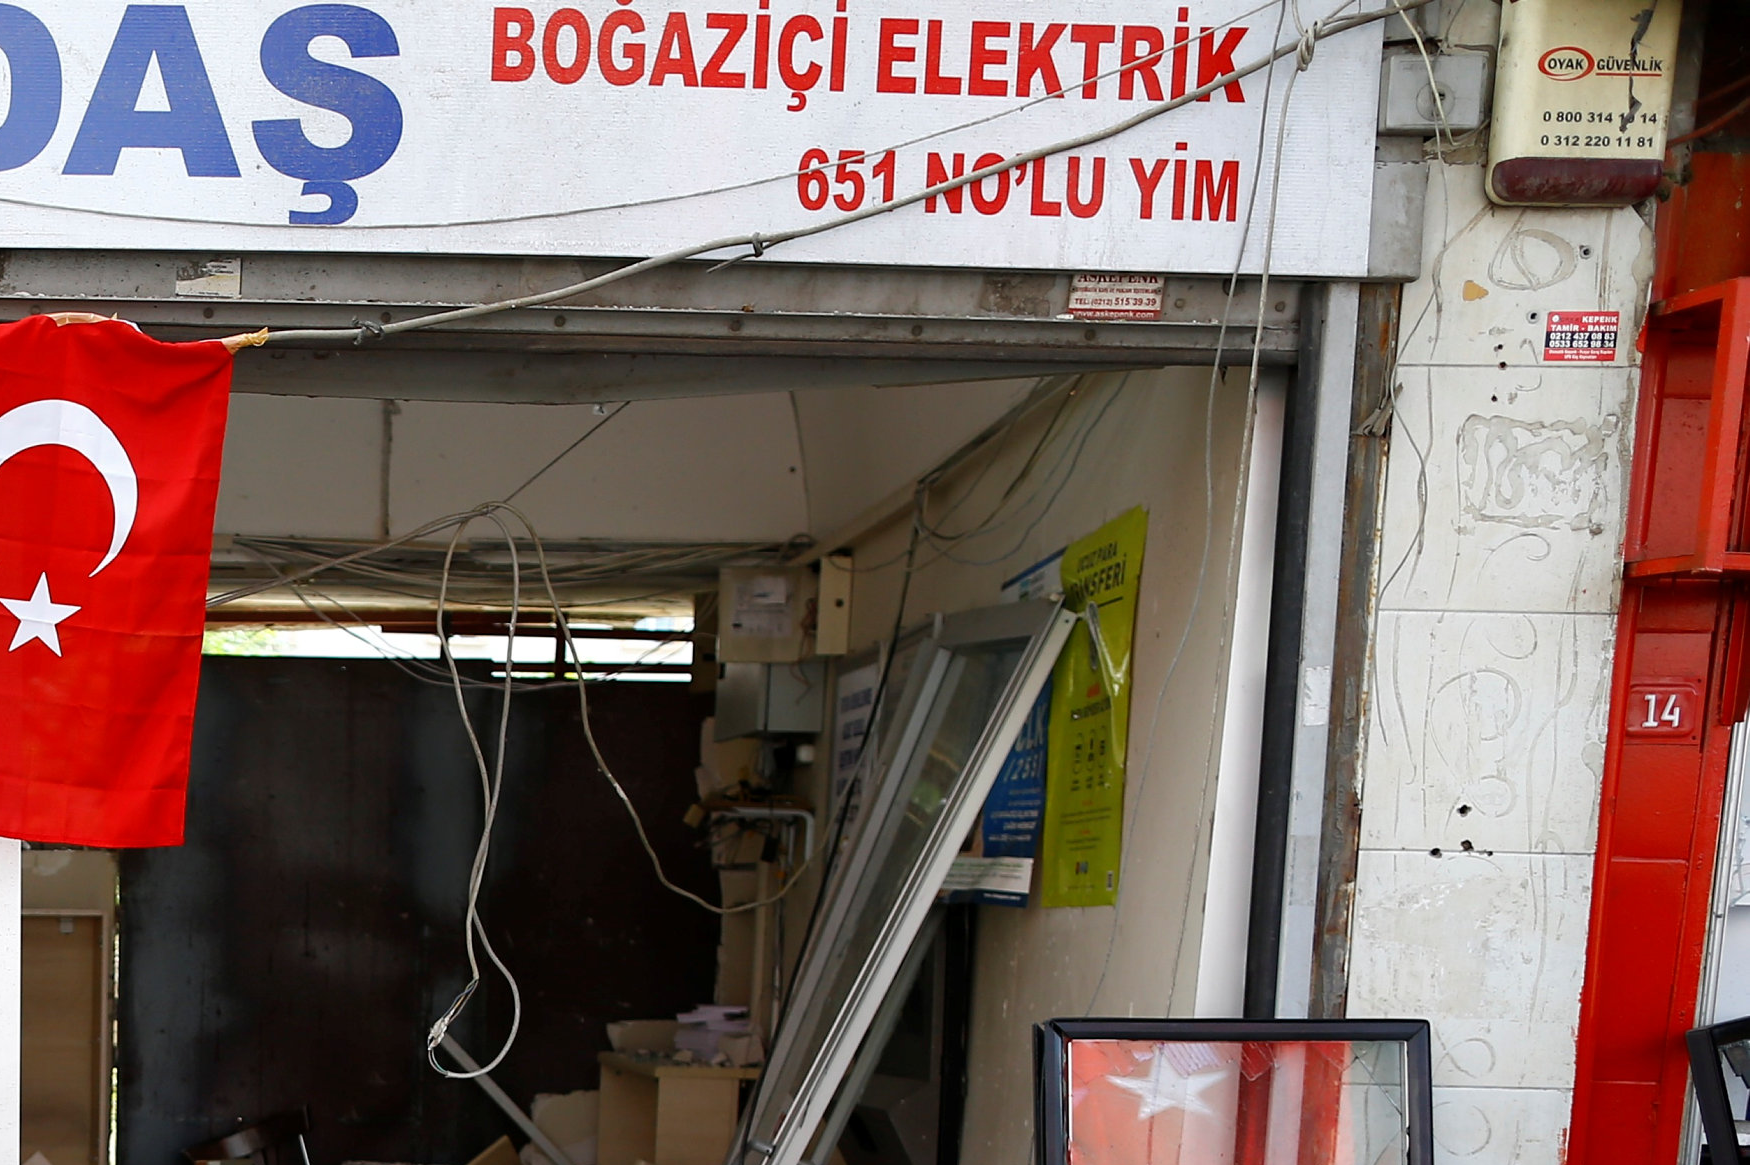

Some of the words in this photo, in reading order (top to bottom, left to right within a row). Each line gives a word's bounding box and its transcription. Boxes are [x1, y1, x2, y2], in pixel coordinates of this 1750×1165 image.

[491, 0, 847, 112] BOĞAZİÇİ
[876, 7, 1249, 103] ELEKTRİK
[1547, 58, 1585, 70] OYAK
[1596, 56, 1663, 71] GÜVENLİK
[1543, 111, 1552, 122] 0
[1556, 111, 1582, 123] 800
[1587, 112, 1613, 123] 314
[1640, 113, 1657, 124] 14
[1540, 134, 1549, 146] 0
[1553, 135, 1580, 147] 312
[1584, 136, 1611, 147] 220
[1616, 136, 1631, 147] 11
[1637, 137, 1654, 147] 81
[797, 148, 896, 212] 651
[1129, 142, 1240, 222] YİM
[1091, 298, 1113, 306] (0212)
[1114, 297, 1130, 305] 515
[1132, 298, 1143, 306] 39
[1550, 323, 1579, 331] TAMİR
[1550, 332, 1571, 340] 0212
[1573, 332, 1590, 340] 437
[1549, 340, 1570, 348] 0533
[1572, 340, 1589, 348] 652
[1603, 340, 1614, 348] 34
[1643, 693, 1681, 729] 14
